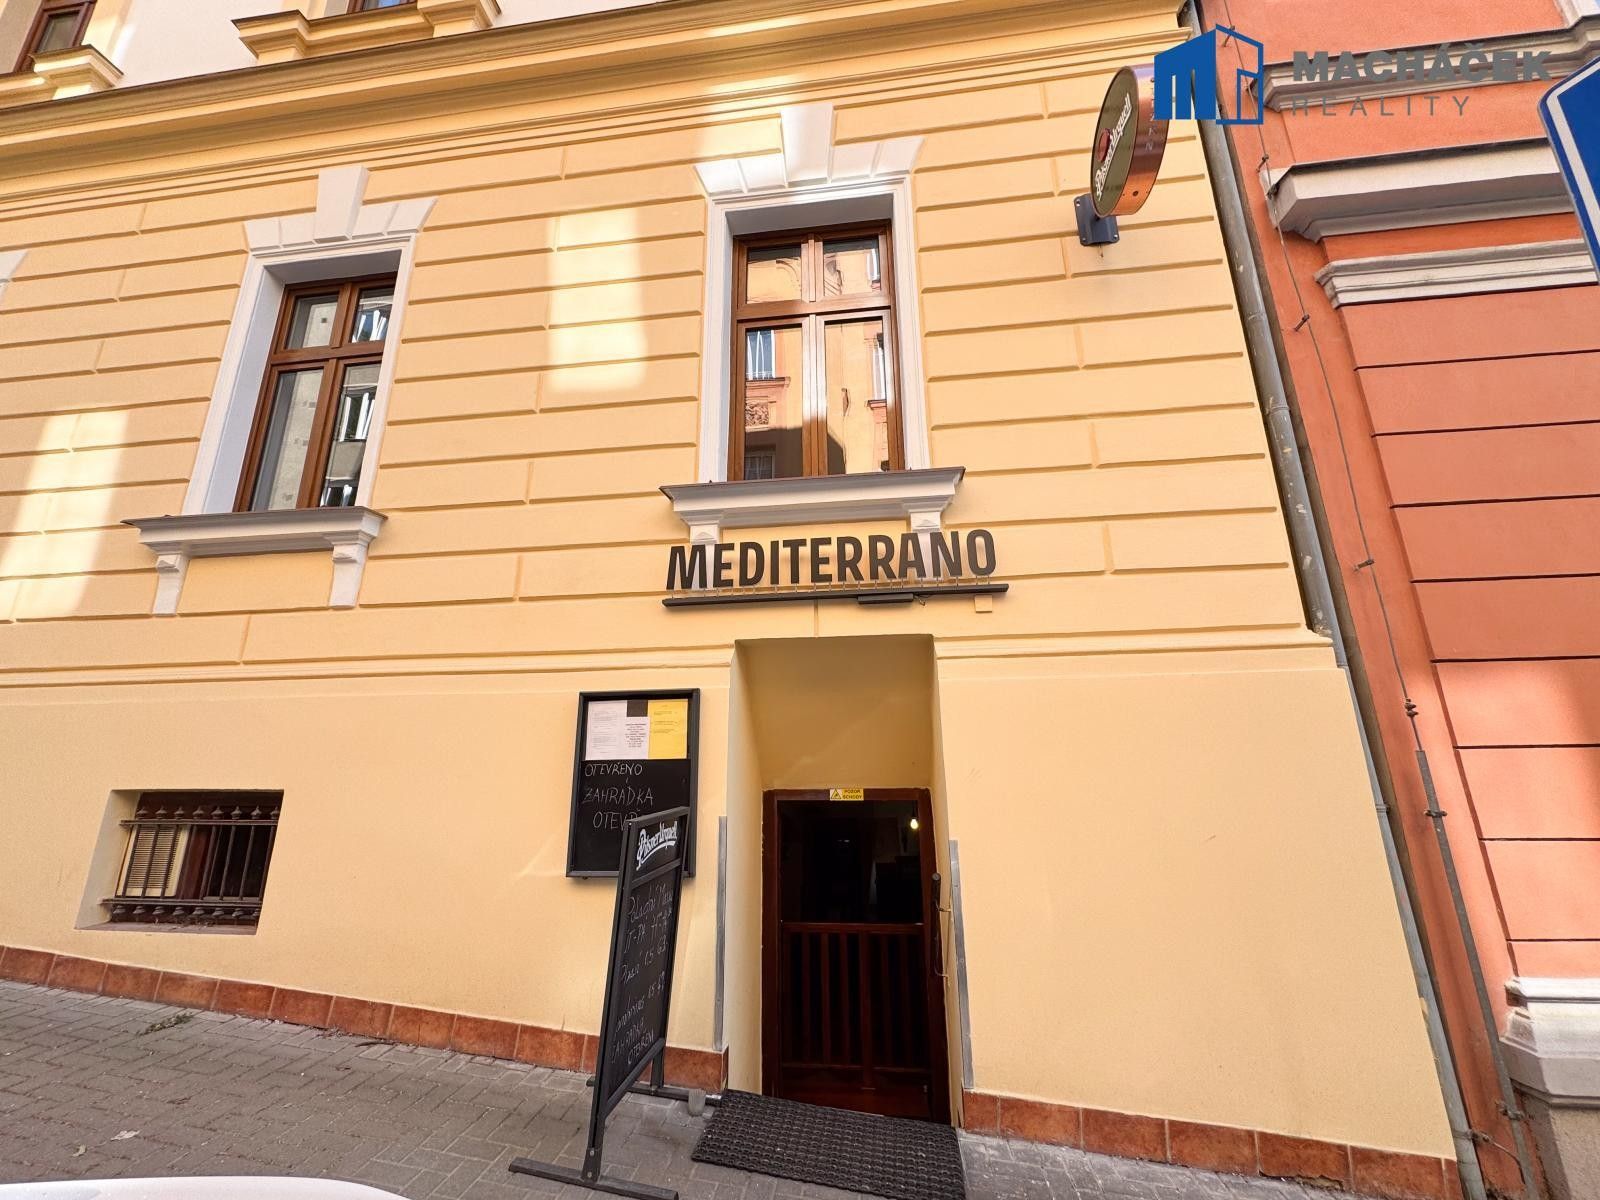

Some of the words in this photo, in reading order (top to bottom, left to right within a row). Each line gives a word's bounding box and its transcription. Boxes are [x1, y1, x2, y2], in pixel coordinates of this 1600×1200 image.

[666, 528, 997, 590] MEDITERRANO
[584, 762, 643, 777] OTEVŘENO
[636, 828, 660, 871] Pilsner
[658, 820, 678, 849] Urquell
